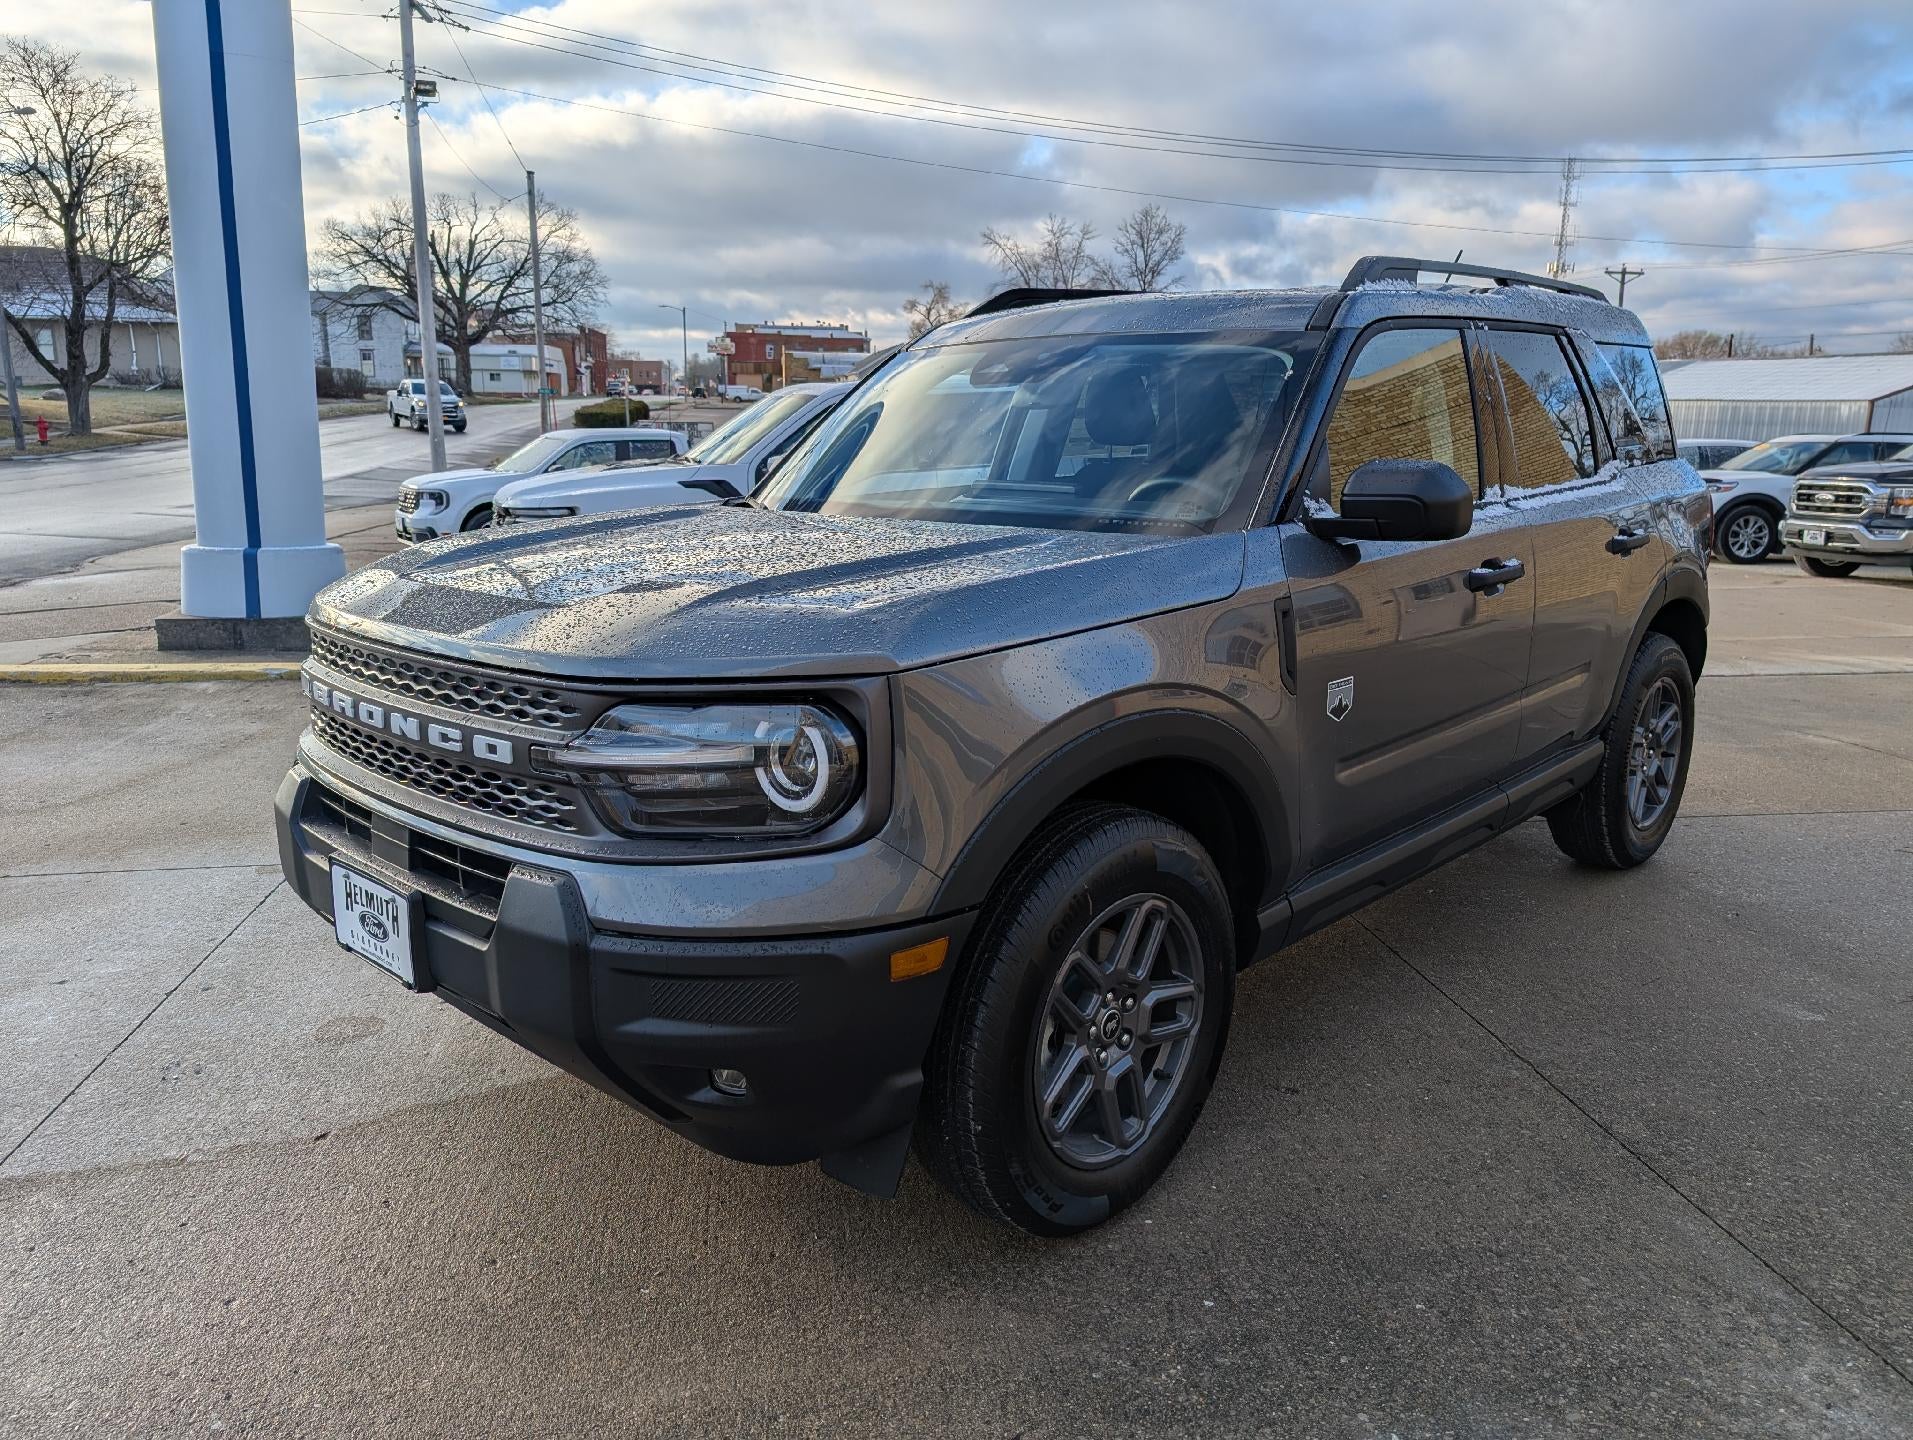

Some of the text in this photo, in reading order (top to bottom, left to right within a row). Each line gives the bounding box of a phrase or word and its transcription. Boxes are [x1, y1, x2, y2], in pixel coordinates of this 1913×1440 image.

[312, 680, 514, 765] BRONCO
[344, 880, 401, 939] HELMUTH
[361, 913, 387, 940] Ford
